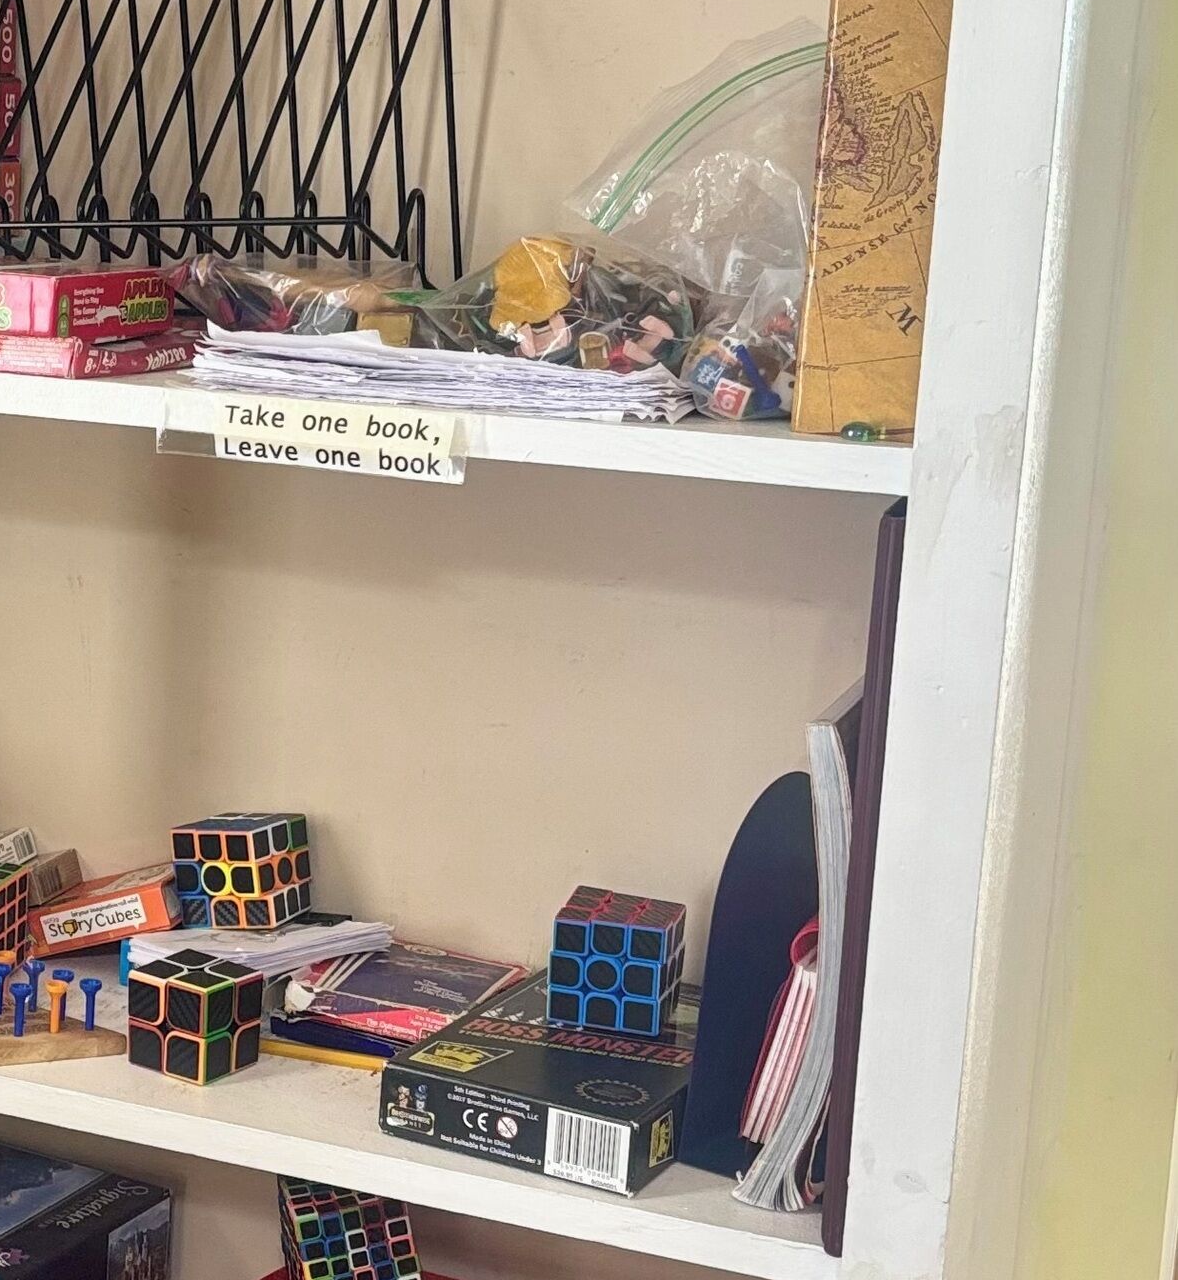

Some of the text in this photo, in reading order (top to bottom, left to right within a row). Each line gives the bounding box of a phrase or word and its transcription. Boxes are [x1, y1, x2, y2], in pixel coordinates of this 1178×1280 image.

[125, 279, 166, 299] APPLES
[128, 300, 168, 320] APPLES
[145, 346, 187, 371] Yahtzee
[225, 405, 441, 447] Take one book,
[223, 437, 441, 476] Leave one book
[94, 907, 142, 927] Cubes
[462, 1018, 548, 1040] BOSS
[548, 1030, 695, 1064] MONSTER
[465, 1087, 531, 1111] Edition Third Printing
[462, 1109, 489, 1133] CE
[527, 1112, 540, 1122] LLC
[453, 1137, 536, 1164] Suitable for Children Under
[469, 1133, 511, 1149] Made China
